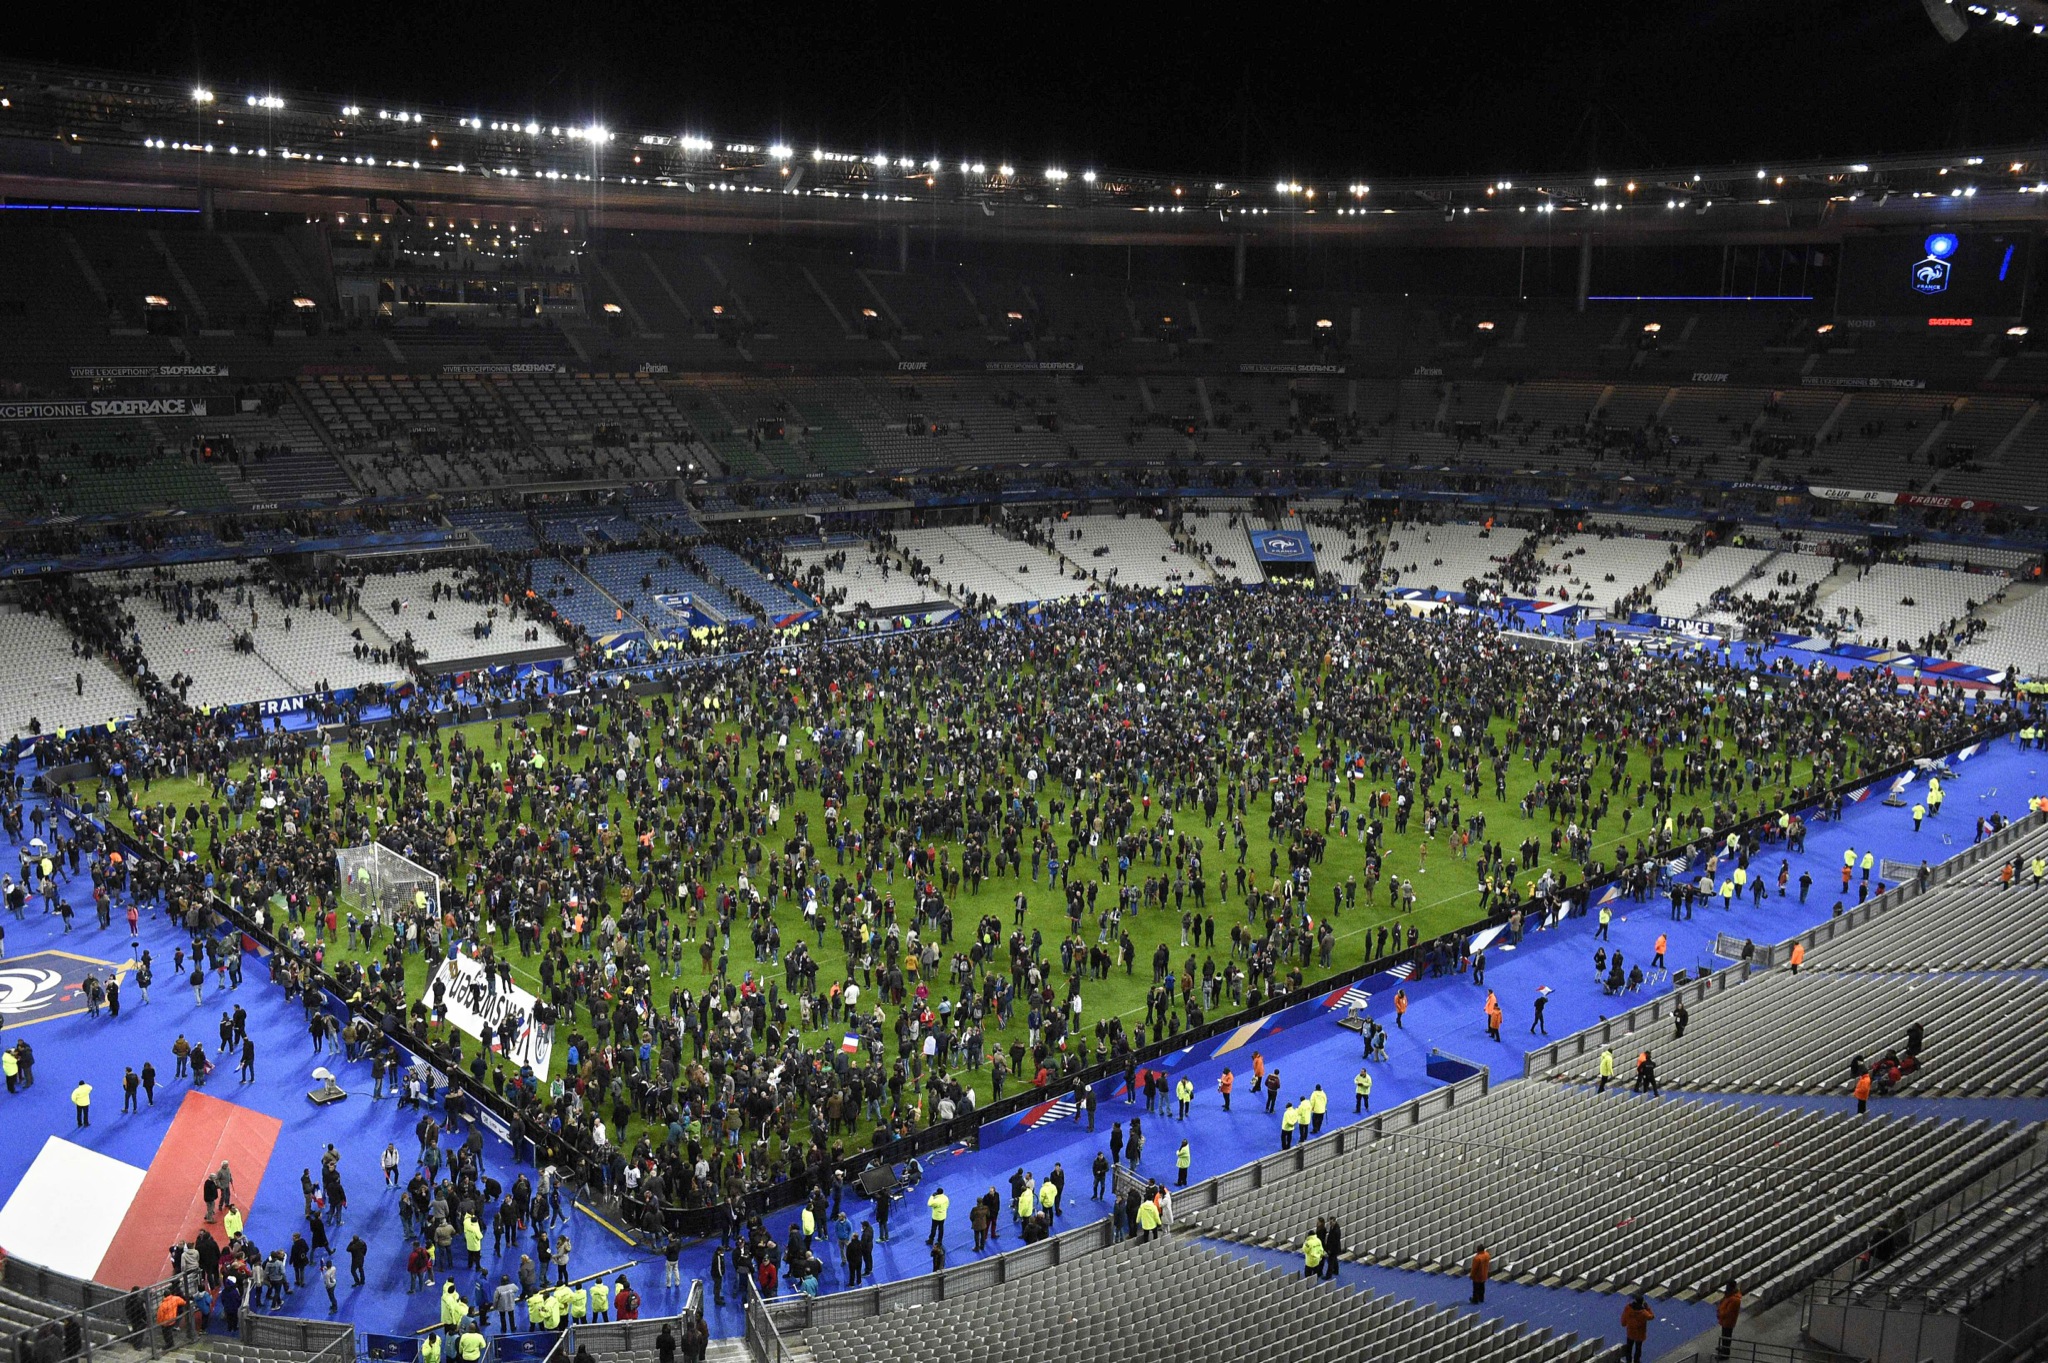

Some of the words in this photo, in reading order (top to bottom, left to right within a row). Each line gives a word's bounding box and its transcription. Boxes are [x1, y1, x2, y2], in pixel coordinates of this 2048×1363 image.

[1847, 319, 1876, 328] NORD
[70, 368, 95, 376] VIVRE
[462, 365, 511, 373] L'EXCEPTIONNEL
[90, 399, 186, 415] STADEFRANCE
[1825, 489, 1850, 497] CLUB
[1864, 491, 1878, 499] DE
[1909, 495, 1952, 506] FRANCE
[252, 503, 278, 511] FRANCE
[1660, 617, 1710, 634] FRANCE
[259, 693, 324, 716] FRANE
